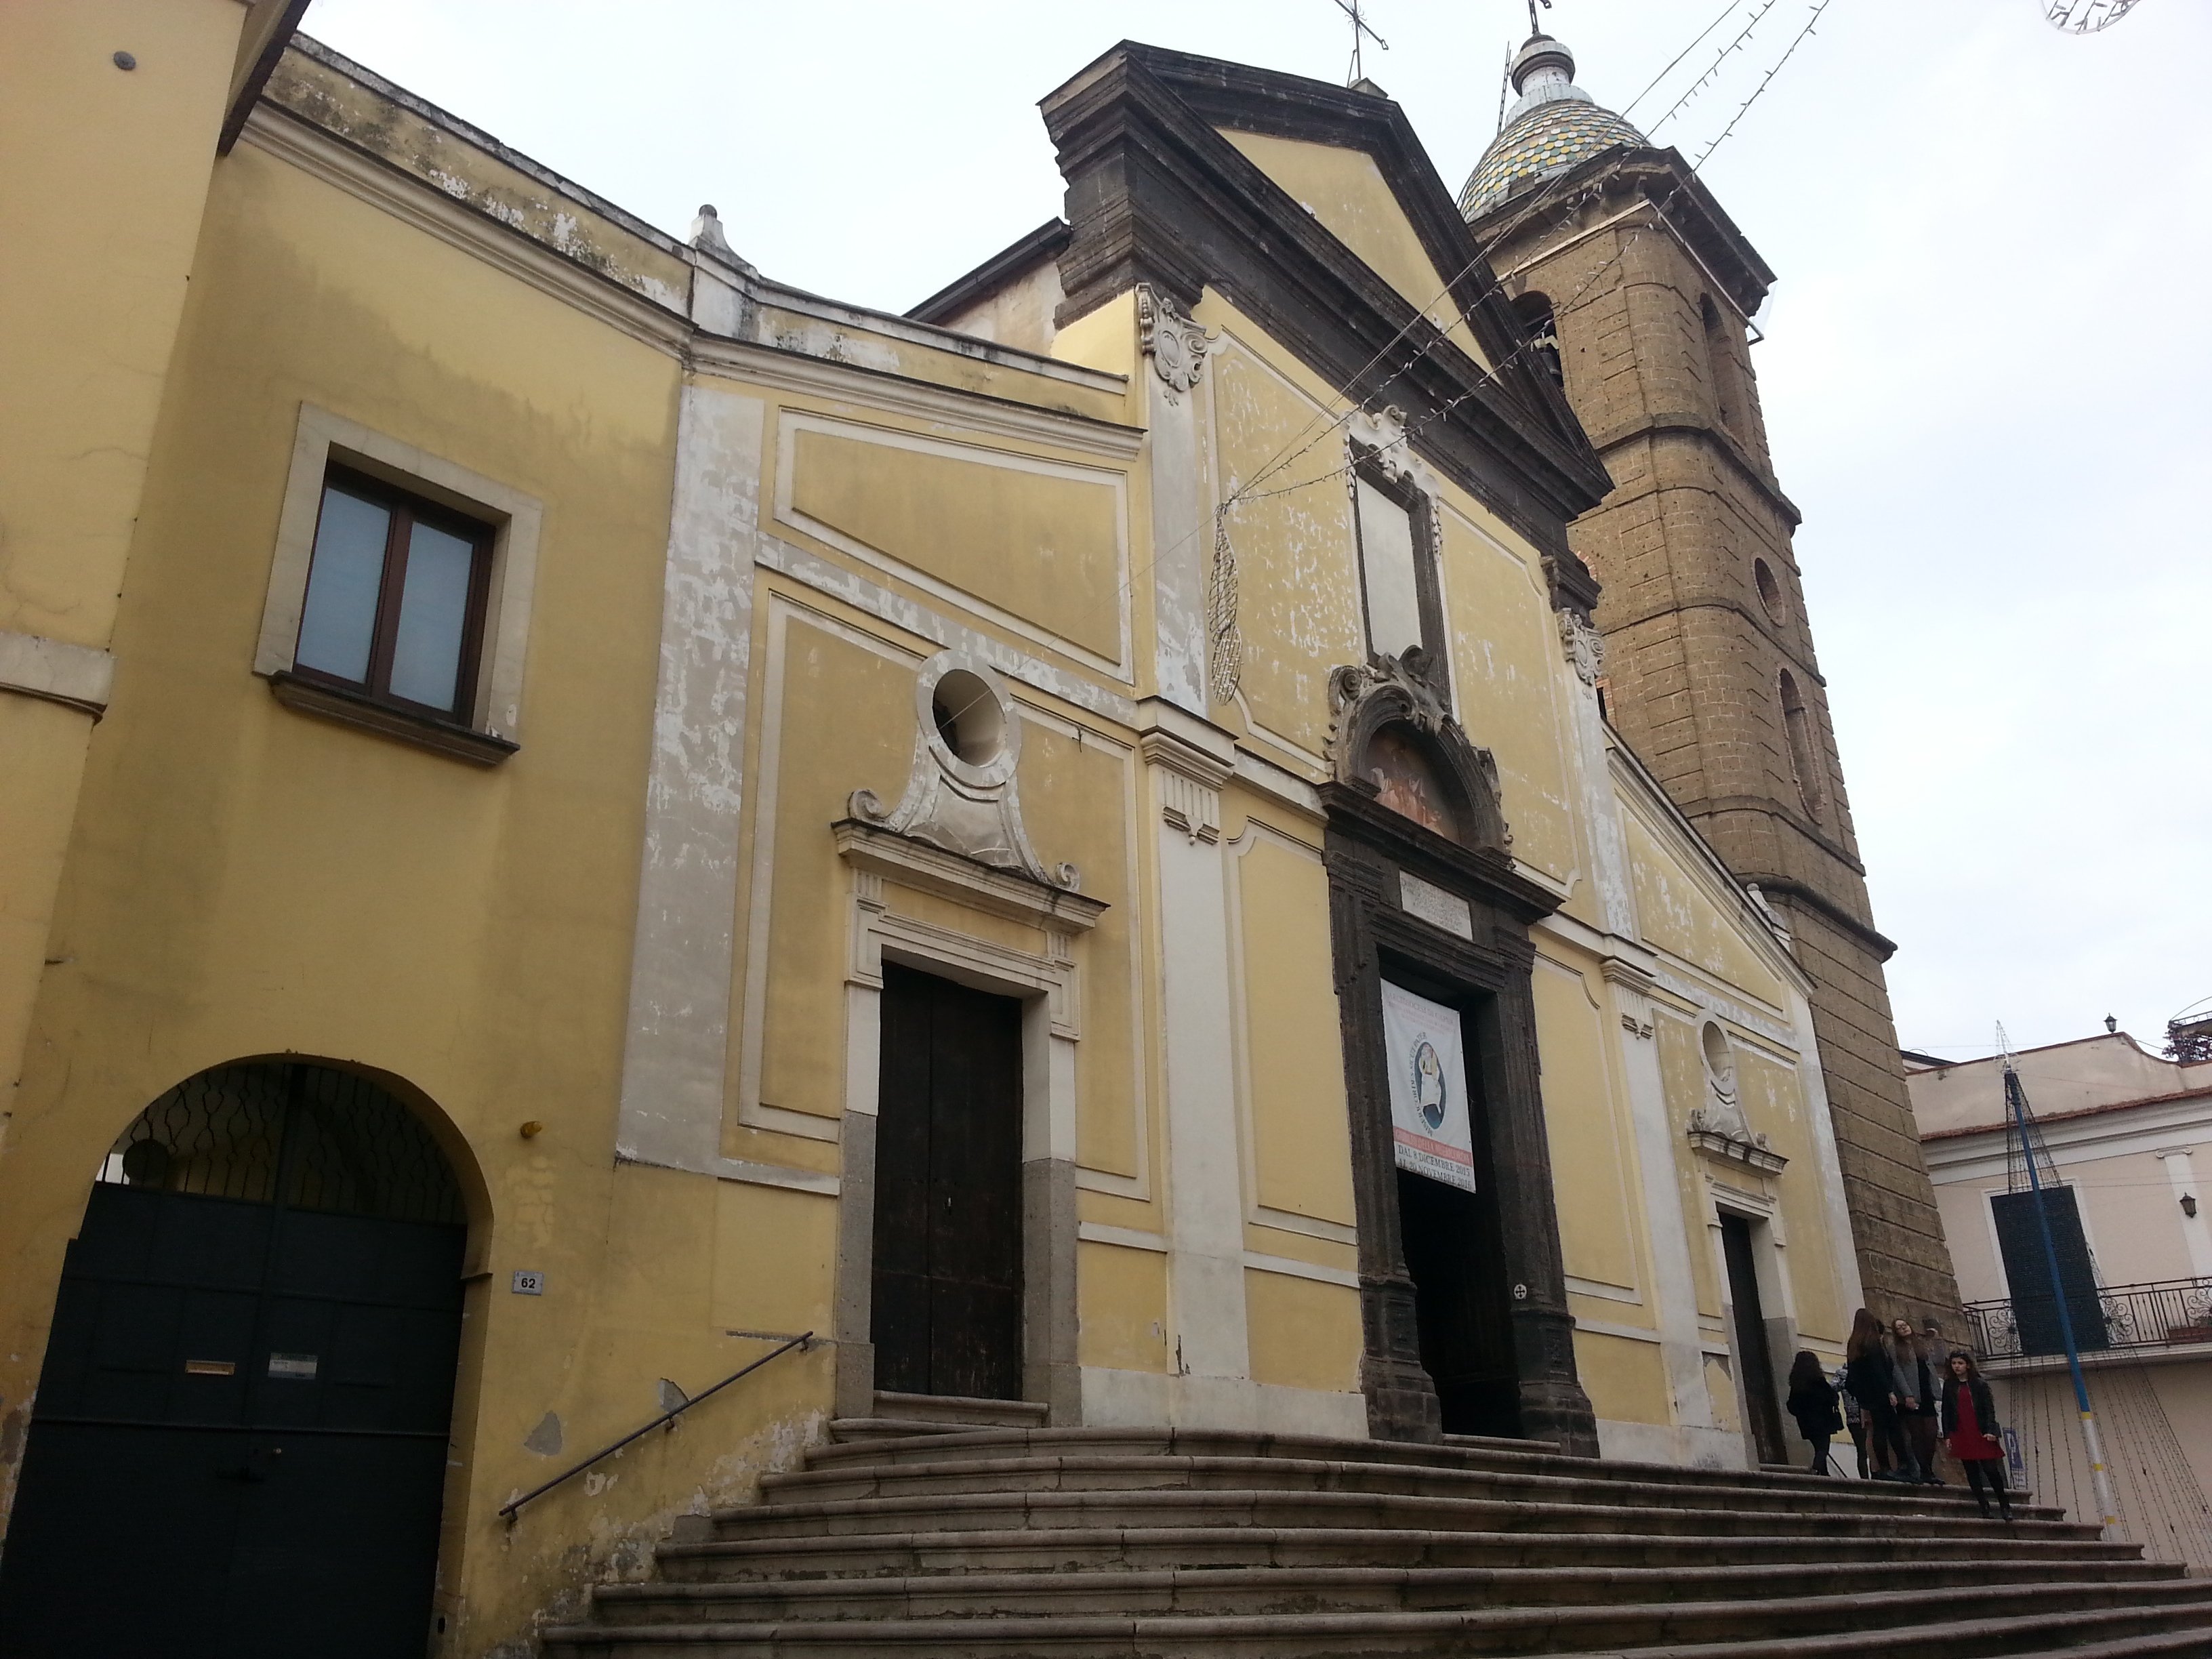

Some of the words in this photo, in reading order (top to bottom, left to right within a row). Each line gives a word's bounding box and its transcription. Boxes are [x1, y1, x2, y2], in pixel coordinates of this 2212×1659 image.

[1398, 1145, 1412, 1158] DAL
[1413, 1151, 1418, 1160] 8
[1418, 1153, 1455, 1172] DICEMBRE
[1456, 1164, 1470, 1177] 2015
[1433, 1142, 1471, 1165] MERICORDIA
[1397, 1158, 1408, 1169] AL
[1409, 1161, 1418, 1172] 20
[1418, 1165, 1457, 1185] NOVEMBRE
[1457, 1176, 1472, 1190] 2016
[521, 1277, 535, 1289] 62
